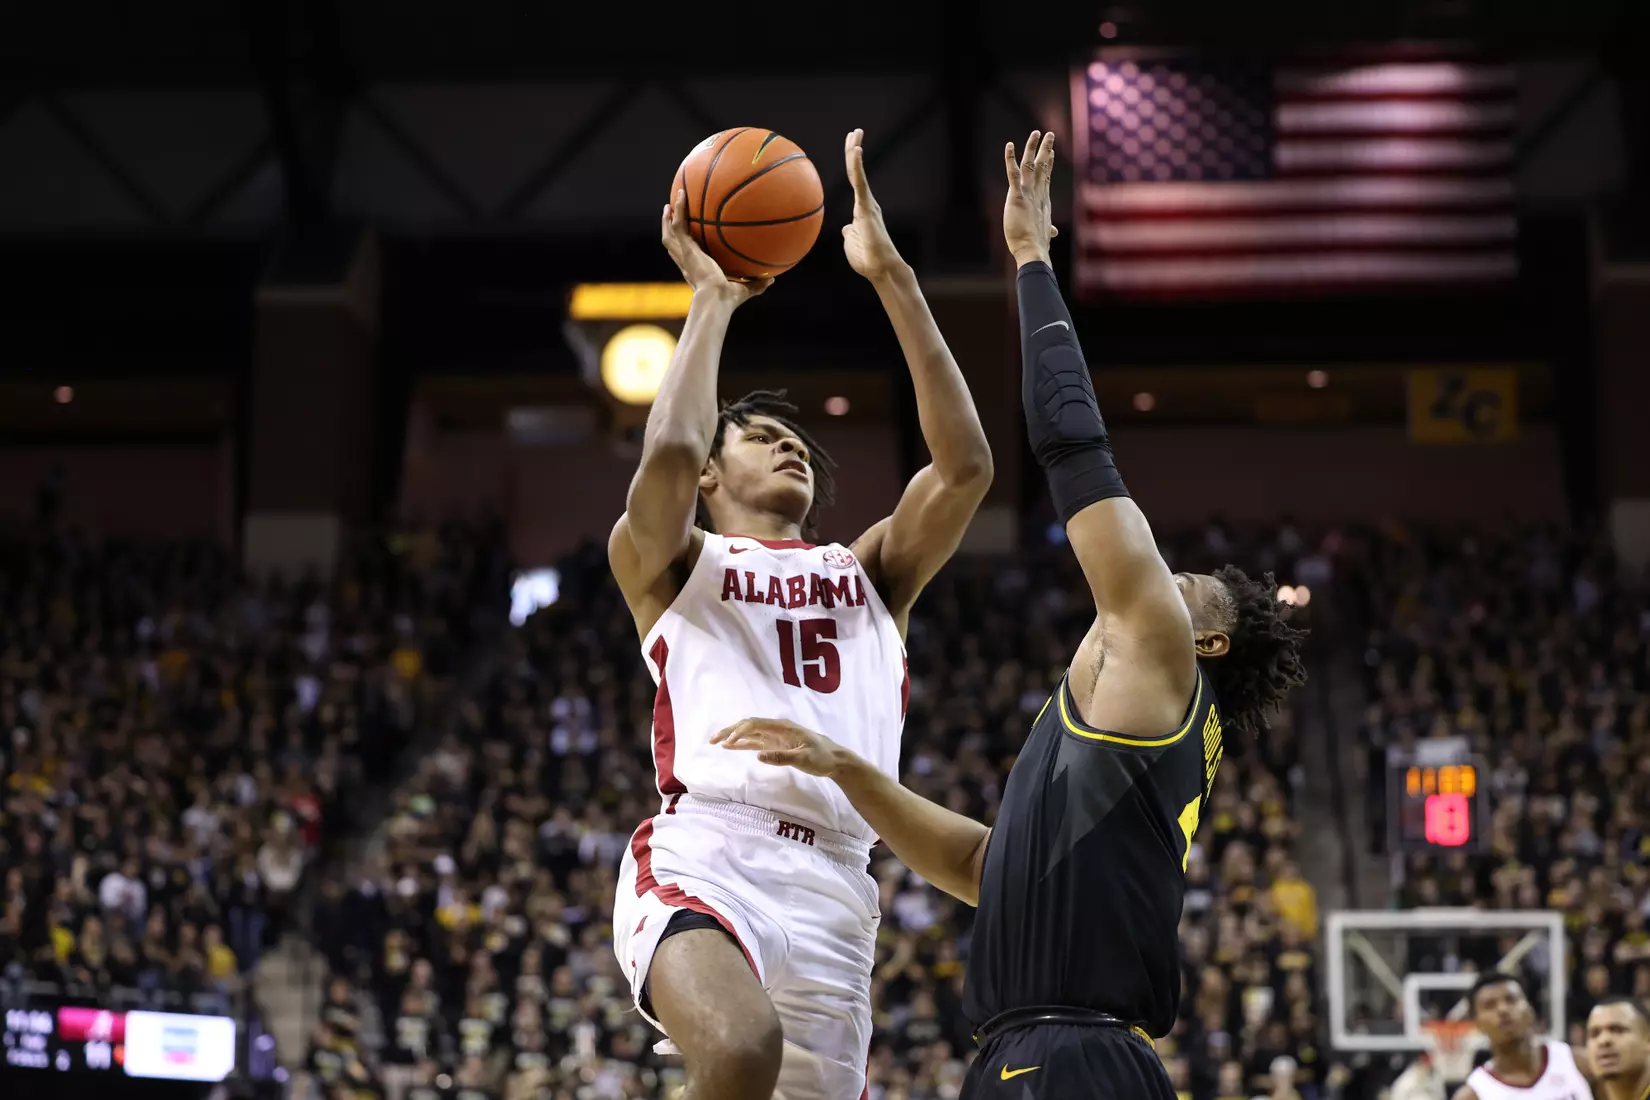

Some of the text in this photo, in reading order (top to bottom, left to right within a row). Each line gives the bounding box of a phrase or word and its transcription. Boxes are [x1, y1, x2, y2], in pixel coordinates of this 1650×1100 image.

[721, 568, 866, 609] ALABAMA
[776, 618, 841, 694] 15
[776, 820, 815, 846] RTR
